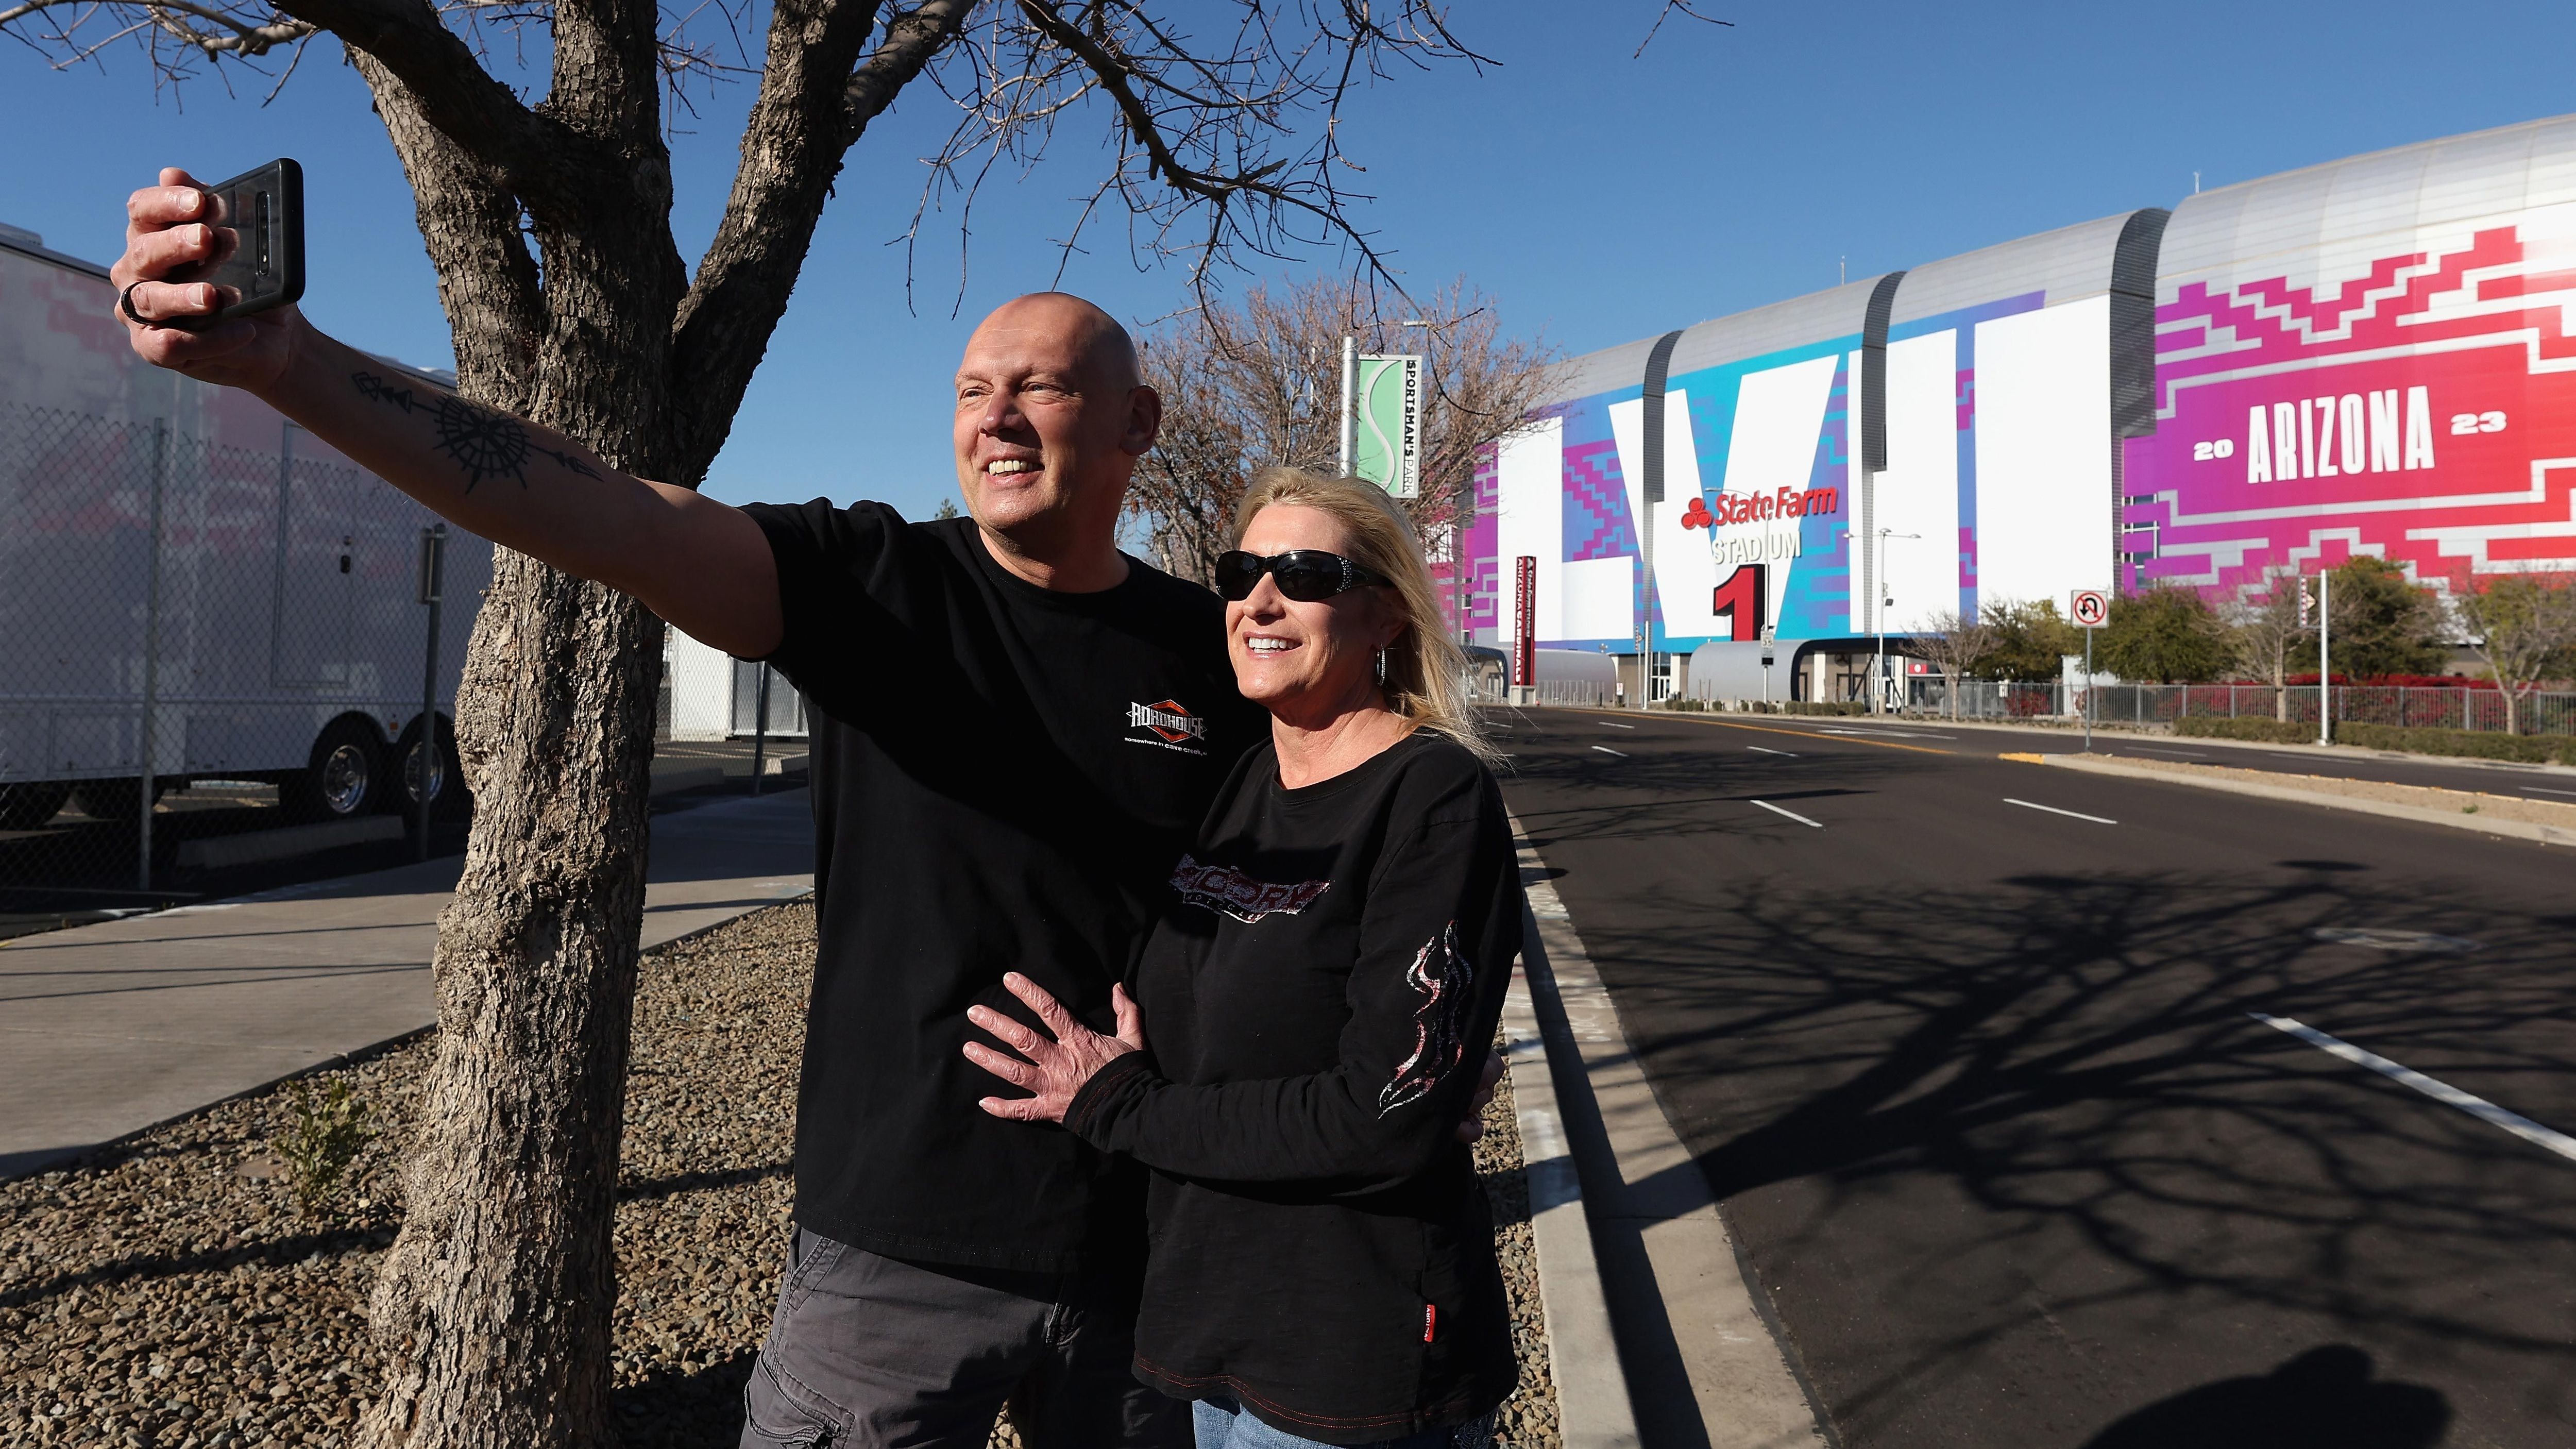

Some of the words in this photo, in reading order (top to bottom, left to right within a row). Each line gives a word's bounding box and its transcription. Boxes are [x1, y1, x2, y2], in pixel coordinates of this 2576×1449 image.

[1405, 360, 1416, 457] SPORTSMAN'S
[2194, 439, 2234, 461] 20
[2247, 385, 2435, 484] ARIZONA
[2451, 411, 2507, 435] 23
[1404, 460, 1414, 493] PARK
[1714, 490, 1774, 526] State
[1775, 486, 1838, 518] Farm
[1711, 531, 1802, 564] STADIUM
[1131, 701, 1205, 741] ROADHOUSE
[1124, 737, 1157, 746] somewhere
